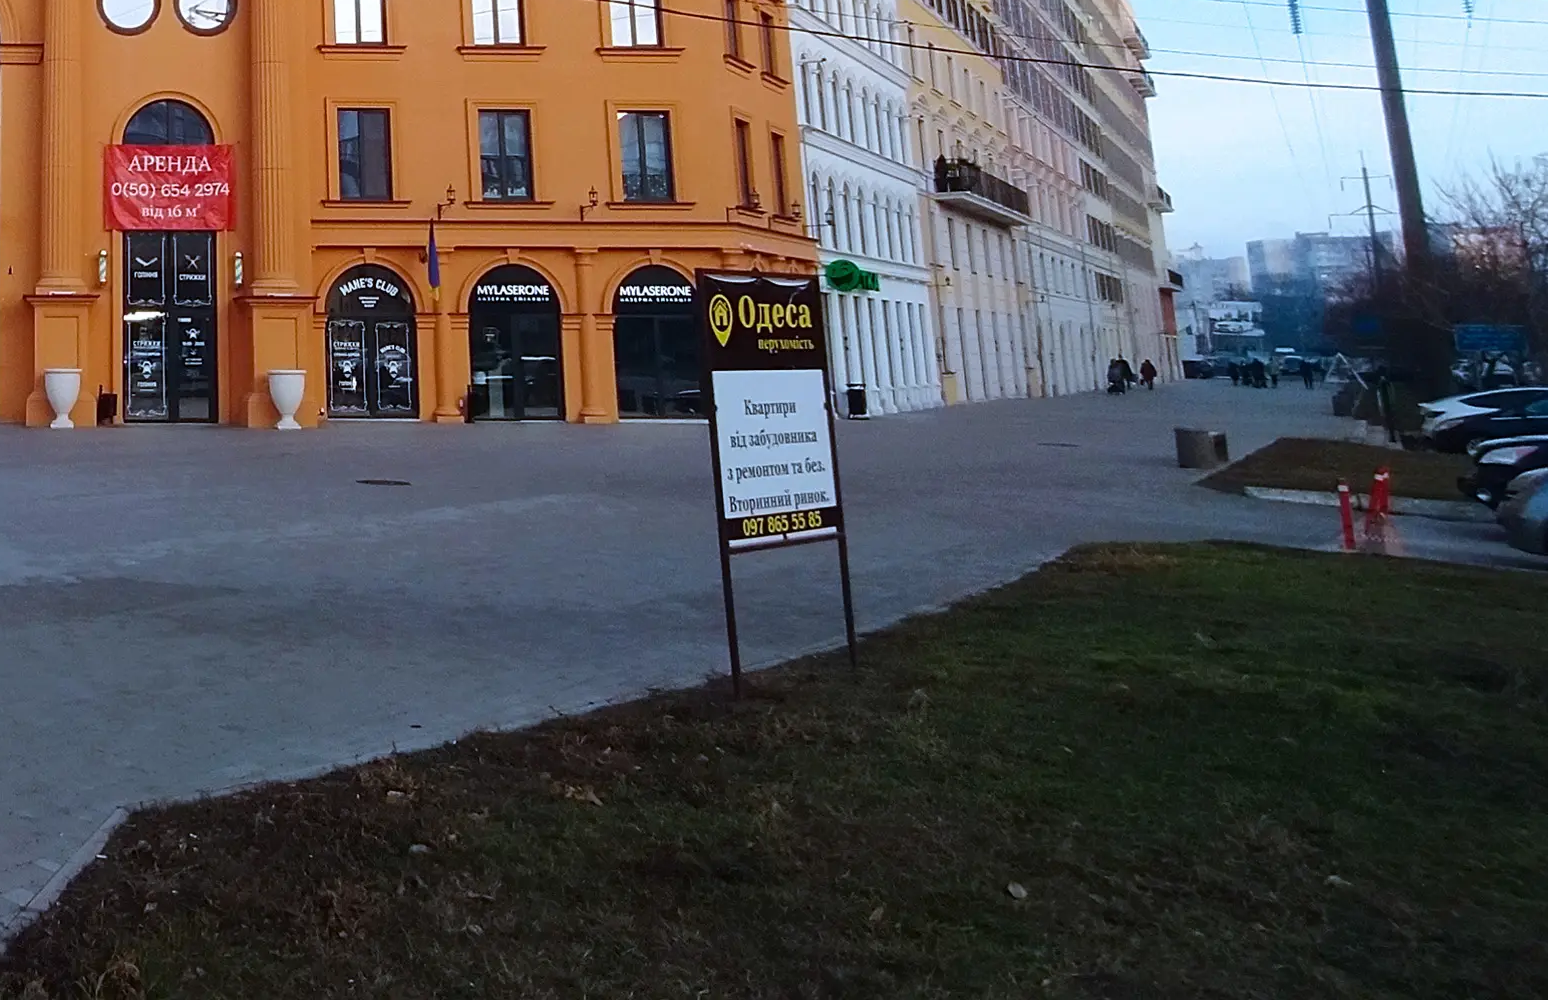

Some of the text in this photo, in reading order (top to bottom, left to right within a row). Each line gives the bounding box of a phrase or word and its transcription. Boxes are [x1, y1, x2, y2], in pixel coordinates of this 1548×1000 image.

[128, 155, 212, 175] АРЕНДА
[112, 182, 230, 198] 0(50) 654 2974
[142, 205, 164, 219] від
[167, 204, 182, 217] 16
[375, 278, 399, 297] CLUB
[477, 285, 550, 296] MYLASERONE
[619, 285, 692, 297] MYLASERONE
[738, 295, 813, 334] Одеса
[758, 335, 815, 354] нерухомість
[744, 399, 797, 419] Квартири
[730, 429, 818, 450] від забудовника
[727, 456, 826, 484] з ремонтом та без.
[729, 488, 830, 515] Вторинний ринок.
[742, 510, 822, 537] 097 865 55 85
